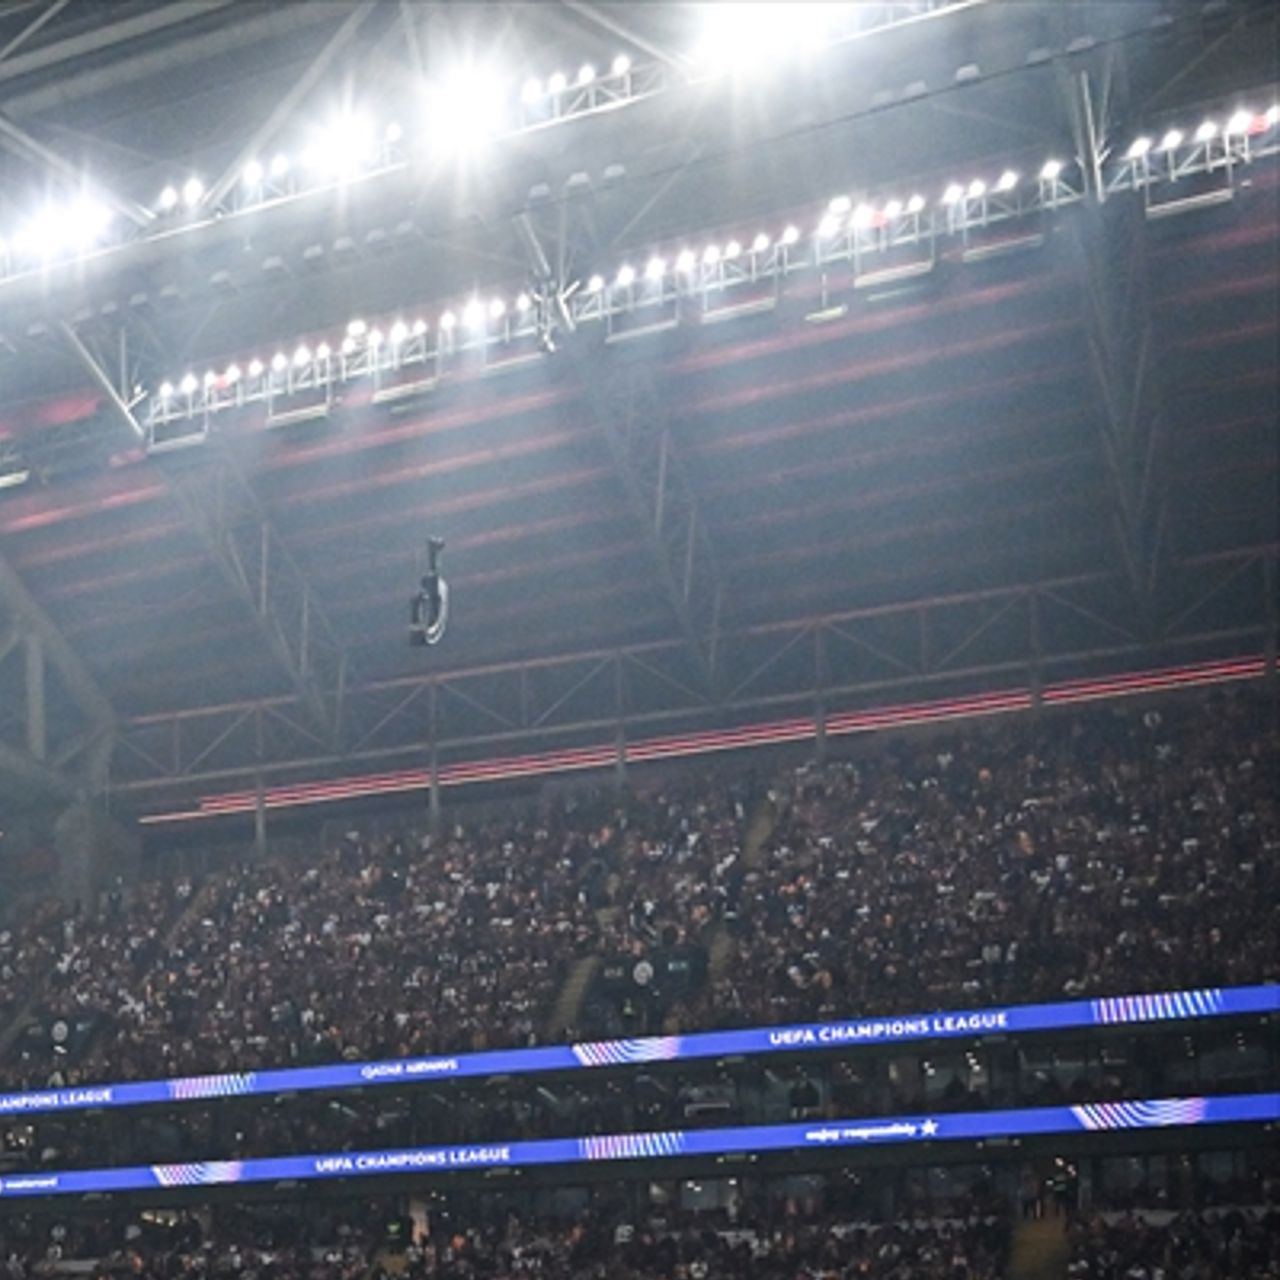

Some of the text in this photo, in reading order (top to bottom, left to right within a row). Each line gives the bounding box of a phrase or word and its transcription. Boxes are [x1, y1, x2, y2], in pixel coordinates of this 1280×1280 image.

[770, 1012, 1007, 1044] UEFA CHAMPIONS LEAGUE
[62, 1089, 112, 1105] LEAGUE
[316, 1147, 510, 1172] UEFA CHAMPIONS LEAGUE
